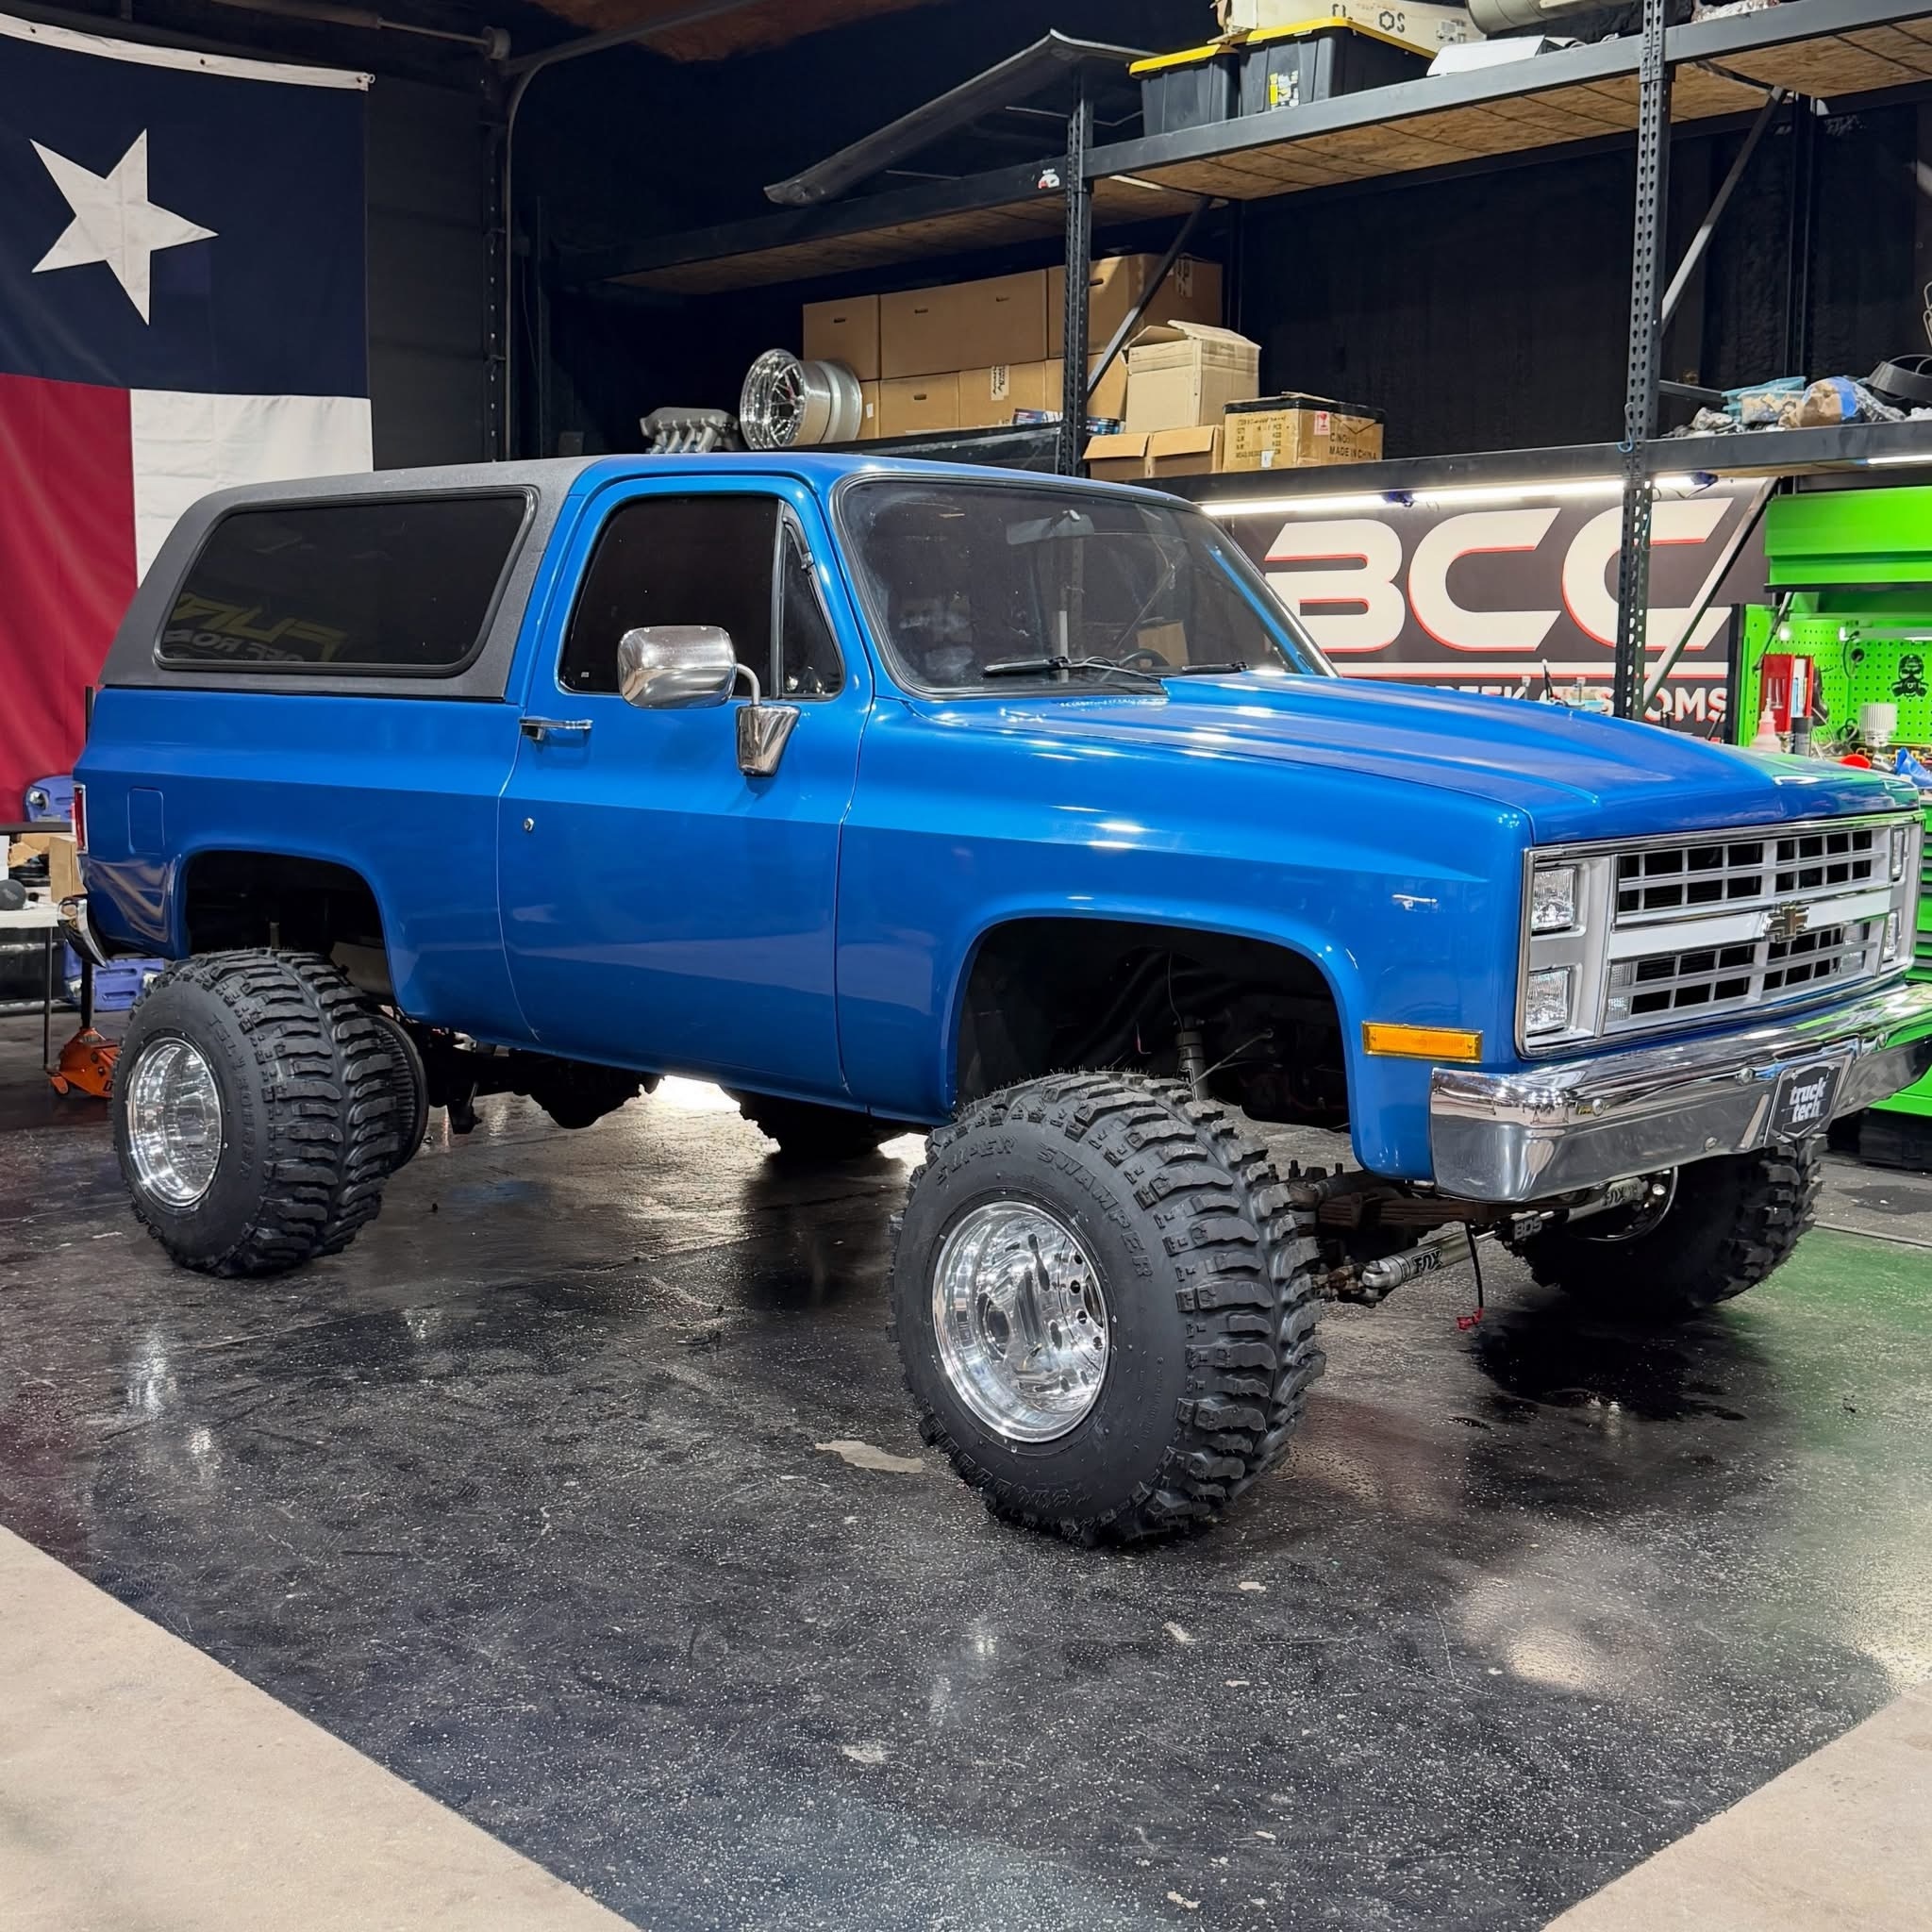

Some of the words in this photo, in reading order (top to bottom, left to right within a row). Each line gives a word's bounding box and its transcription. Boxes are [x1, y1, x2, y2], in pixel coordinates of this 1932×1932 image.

[1329, 444, 1349, 457] MADE
[1358, 448, 1377, 460] CHINA
[1265, 497, 1734, 653] BCC
[1789, 1076, 1827, 1106] truck
[1791, 1094, 1822, 1123] tech
[1037, 1141, 1154, 1284] SWAMPER
[1411, 1247, 1442, 1274] FOX
